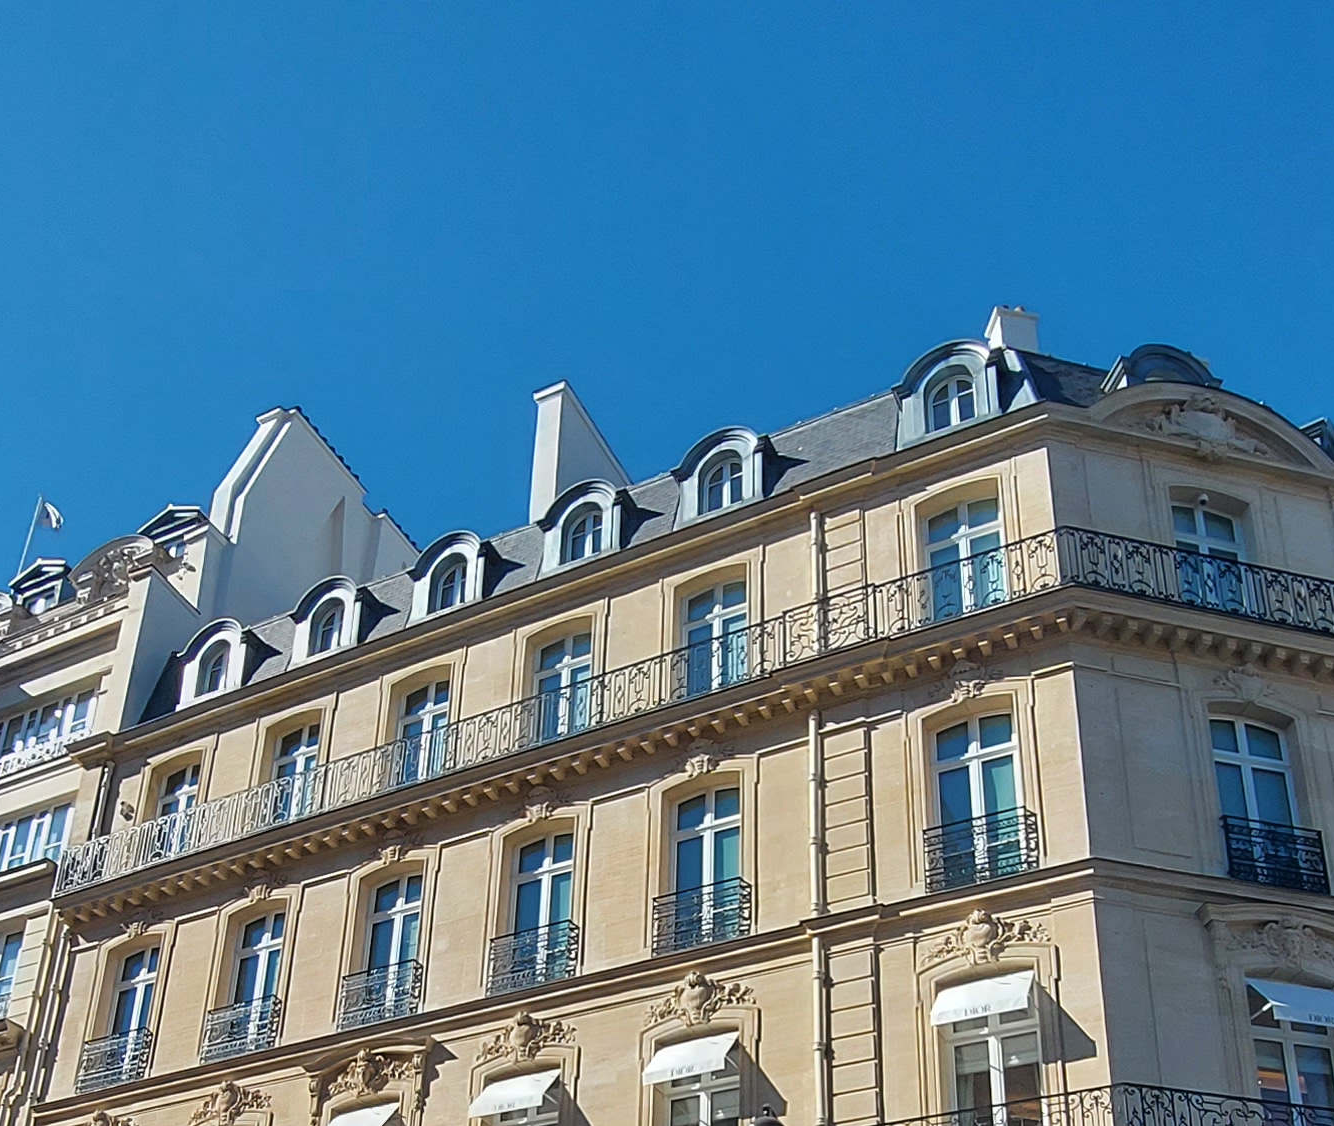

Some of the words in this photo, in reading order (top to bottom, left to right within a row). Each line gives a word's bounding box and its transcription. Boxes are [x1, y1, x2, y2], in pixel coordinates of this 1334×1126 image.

[964, 1004, 991, 1016] DIOR
[1308, 1013, 1334, 1025] DIOR
[671, 1065, 694, 1077] DIOR
